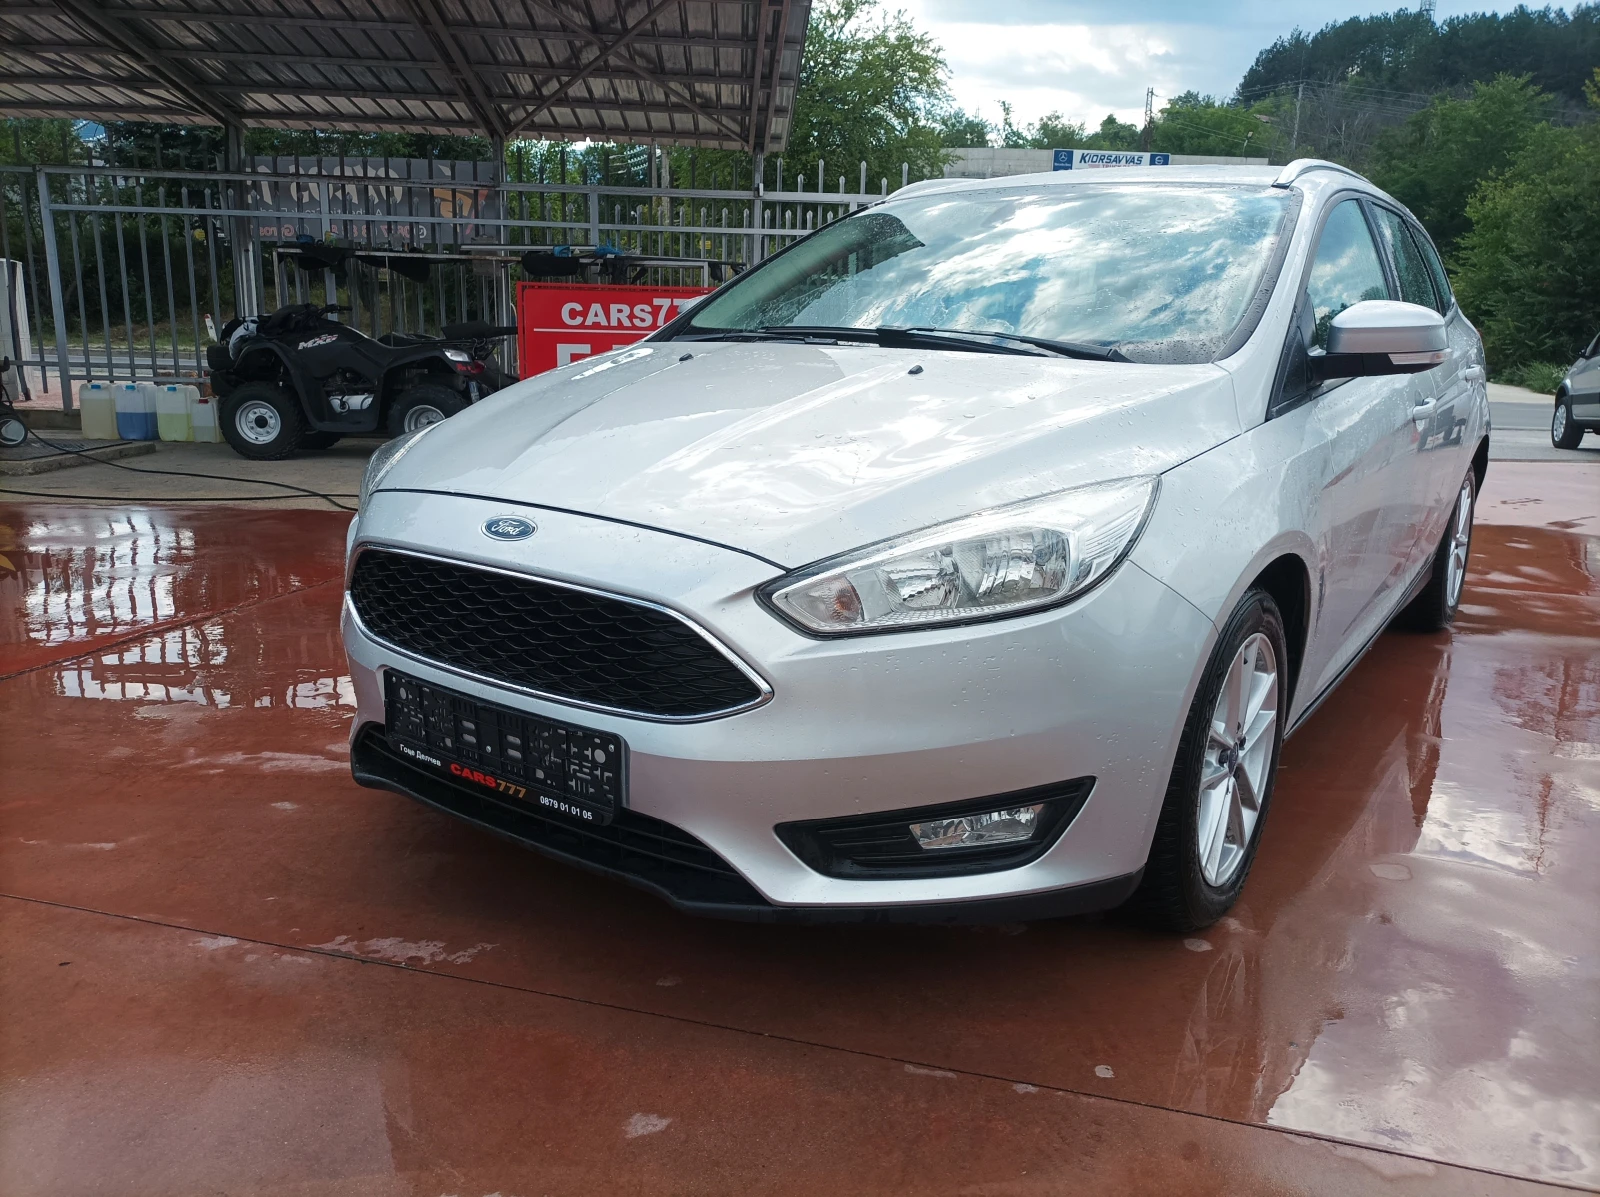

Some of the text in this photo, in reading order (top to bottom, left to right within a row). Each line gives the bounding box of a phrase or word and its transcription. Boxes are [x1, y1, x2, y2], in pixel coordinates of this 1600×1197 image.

[491, 519, 525, 536] Ford
[539, 795, 593, 820] 0879 01 01 05
